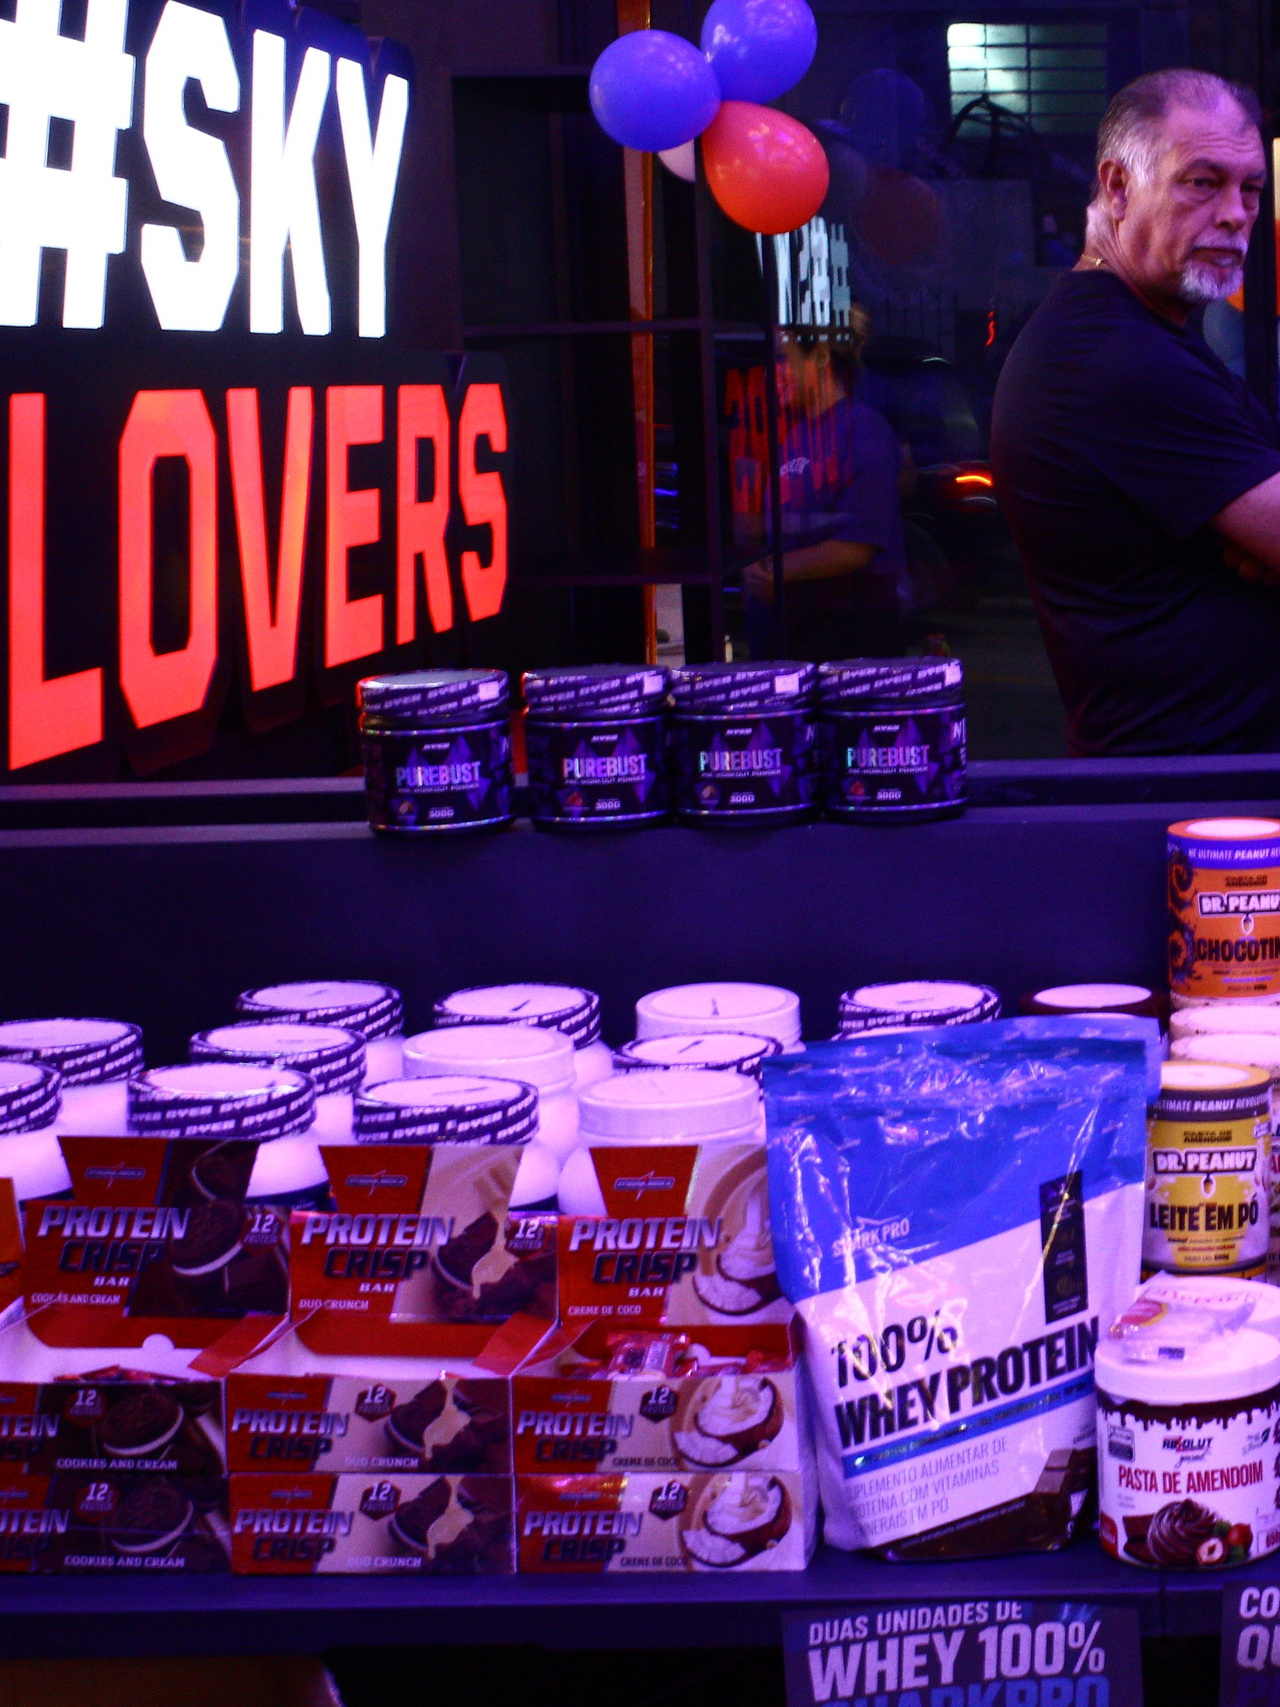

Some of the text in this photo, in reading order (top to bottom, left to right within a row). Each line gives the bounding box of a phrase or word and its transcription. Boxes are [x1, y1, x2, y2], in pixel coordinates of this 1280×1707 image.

[0, 0, 410, 339] #SKY
[8, 383, 509, 771] LOVERS
[563, 753, 647, 779] PUREBUST
[699, 748, 783, 772] PUREBUST
[847, 745, 929, 768] PUREBUST
[396, 761, 481, 788] PUREBUST
[1234, 848, 1270, 860] PEANUT
[1201, 896, 1227, 913] DR.
[1194, 1098, 1235, 1111] PEANUT
[1156, 1150, 1256, 1171] DR. PEANUT
[37, 1205, 193, 1240] PROTEIN
[1150, 1192, 1259, 1231] LEITE EM PÓ
[301, 1213, 455, 1247] PROTEIN
[568, 1215, 724, 1251] PROTEIN
[882, 1217, 911, 1240] PRO
[58, 1238, 167, 1273] CRISP
[324, 1246, 432, 1279] CRISP
[592, 1251, 698, 1284] CRISP
[93, 1276, 130, 1287] BAR
[359, 1282, 395, 1293] BAR
[628, 1286, 664, 1297] BAR
[70, 1292, 89, 1304] AND
[90, 1293, 121, 1304] CREAM
[324, 1298, 369, 1310] CRUNCH
[568, 1303, 642, 1316] CREME DE COCO
[830, 1309, 960, 1389] 100%
[834, 1370, 943, 1449] WHEY
[945, 1315, 1099, 1415] PROTEIN
[0, 1414, 60, 1437] TEIN
[231, 1407, 350, 1437] PROTEIN
[517, 1410, 635, 1437] PROTEIN
[249, 1436, 333, 1460] CRISP
[535, 1437, 617, 1461] CRISP
[921, 1443, 989, 1479] ALIMENTAR
[992, 1436, 1008, 1454] DE
[56, 1458, 178, 1470] COOKIES AND CREAM
[371, 1457, 420, 1468] CRUNCH
[613, 1456, 680, 1467] CREME DE COCO
[900, 1461, 1000, 1506] COM VITAMINAS
[1118, 1460, 1264, 1494] PASTA DE AMENDOIM
[233, 1508, 354, 1537] PROTEIN
[910, 1496, 949, 1523] EM PÓ
[523, 1510, 644, 1537] PROTEIN
[252, 1534, 337, 1561] CRISP
[543, 1537, 626, 1563] CRISP
[64, 1555, 186, 1568] COOKIES AND CREAM
[373, 1556, 422, 1568] CRUNCH
[621, 1556, 688, 1567] CREME DE COCO
[809, 1600, 1023, 1646] DUAS UNIDADES DE
[807, 1619, 1106, 1702] WHEY 100%
